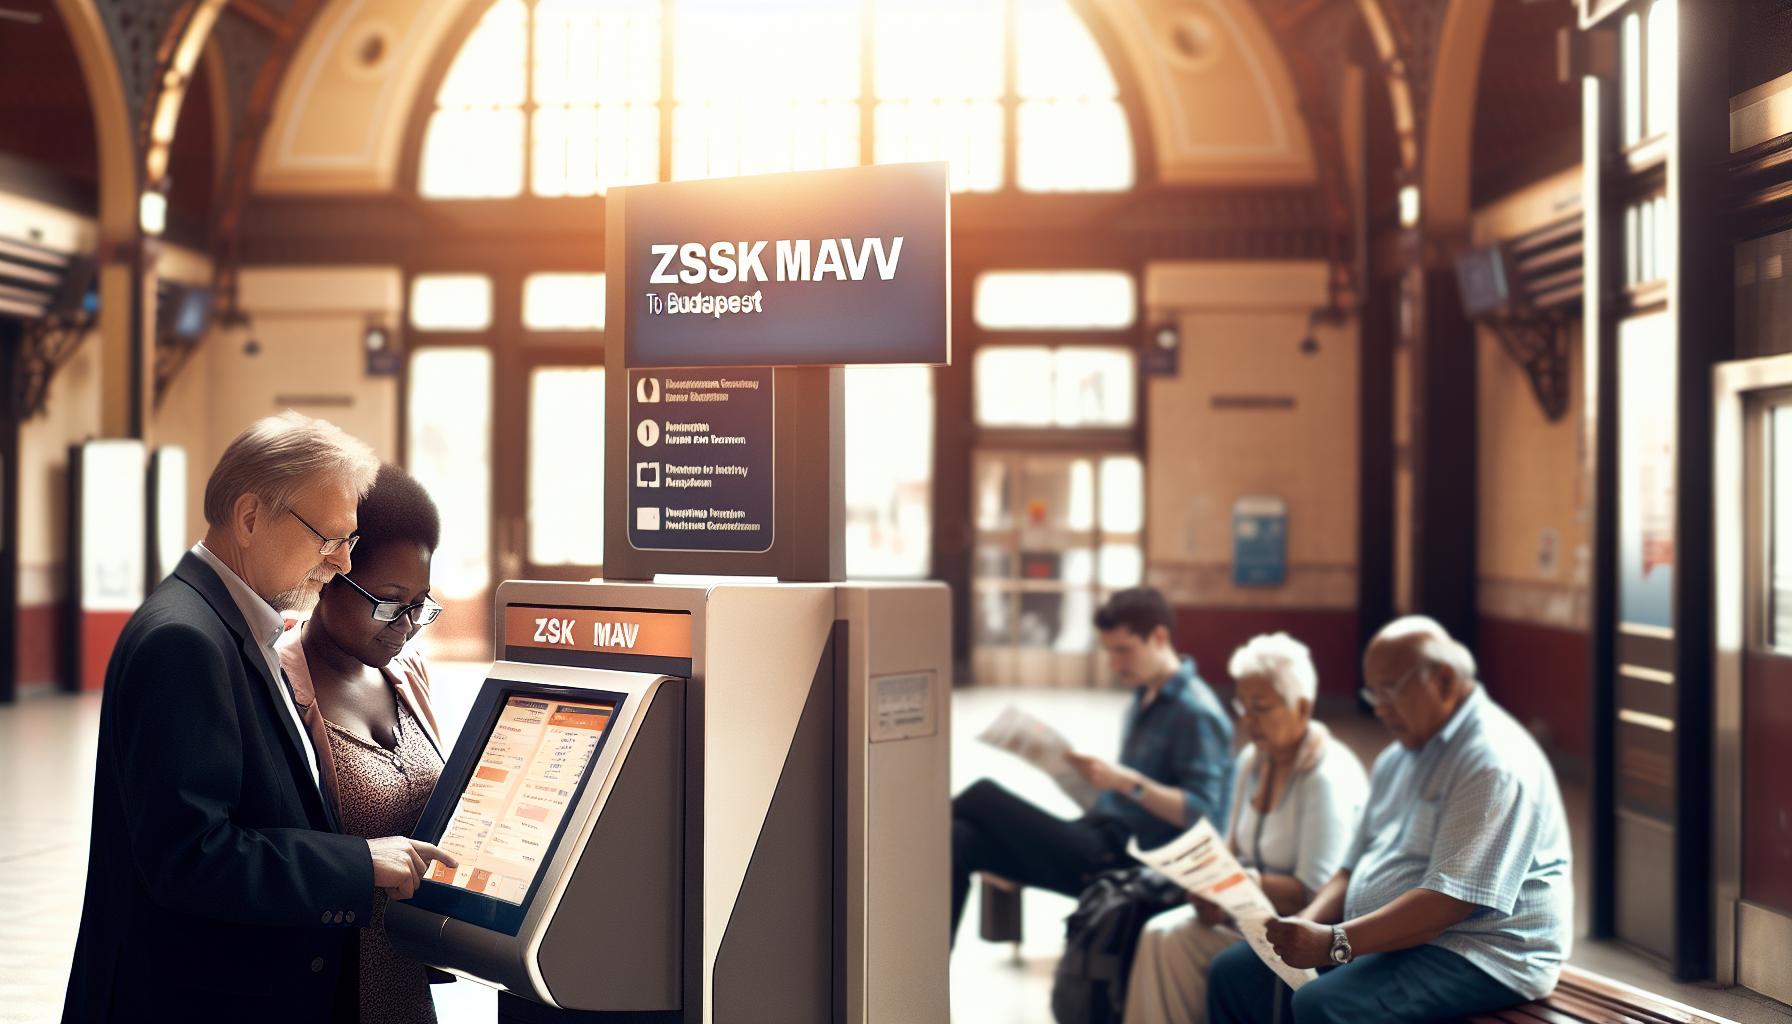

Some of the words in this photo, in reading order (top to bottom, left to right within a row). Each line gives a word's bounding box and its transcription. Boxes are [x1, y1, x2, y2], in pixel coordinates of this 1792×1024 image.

[650, 241, 768, 284] ZSSK
[646, 293, 662, 315] To
[667, 290, 762, 319] Budapest
[533, 618, 576, 645] ZSK
[593, 622, 639, 649] MAV
